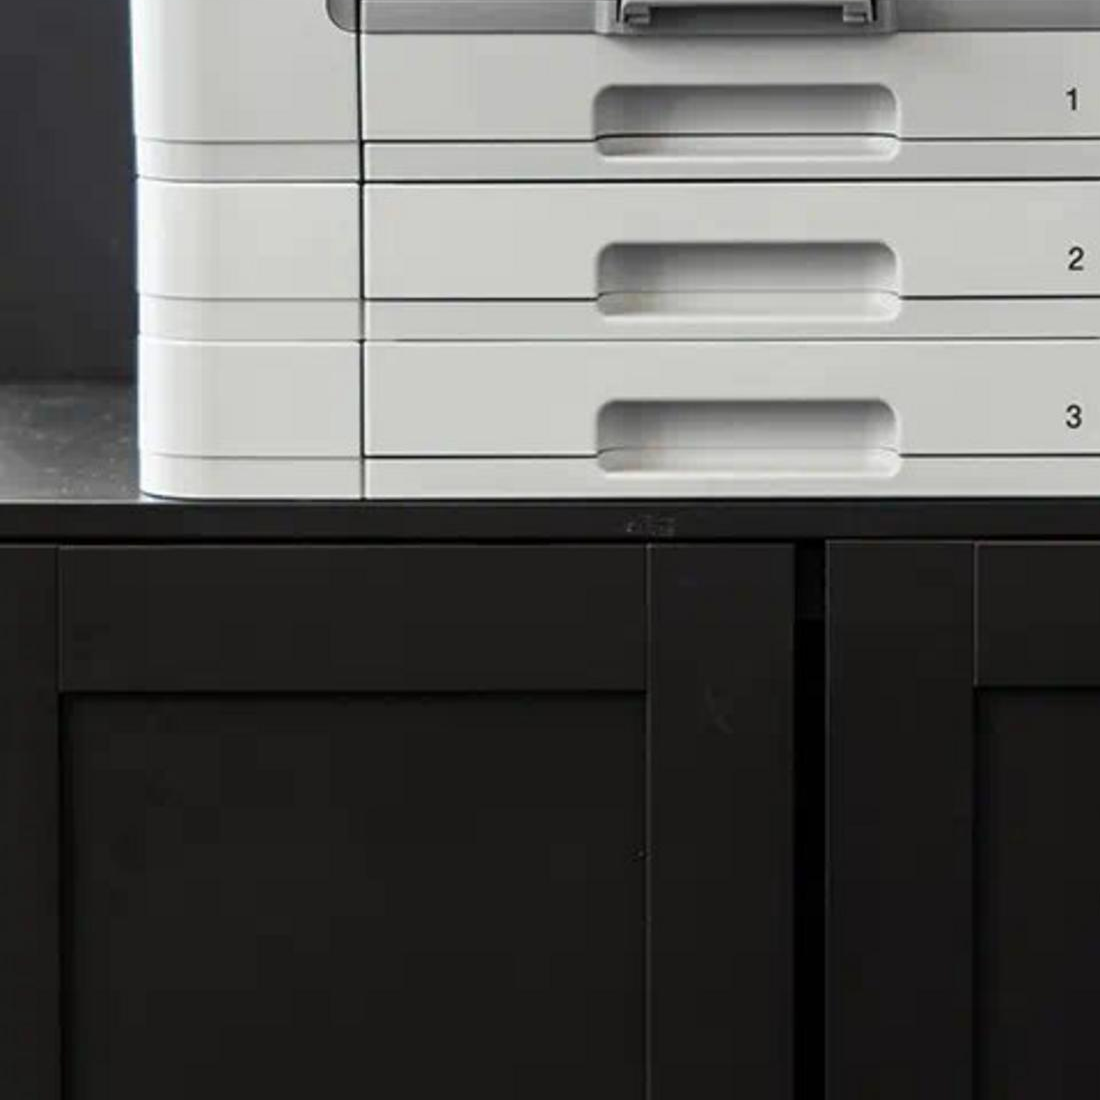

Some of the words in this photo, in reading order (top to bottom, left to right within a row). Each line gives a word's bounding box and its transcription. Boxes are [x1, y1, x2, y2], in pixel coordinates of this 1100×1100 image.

[1065, 87, 1078, 111] 1
[1068, 246, 1085, 271] 2
[1065, 404, 1083, 429] 3
